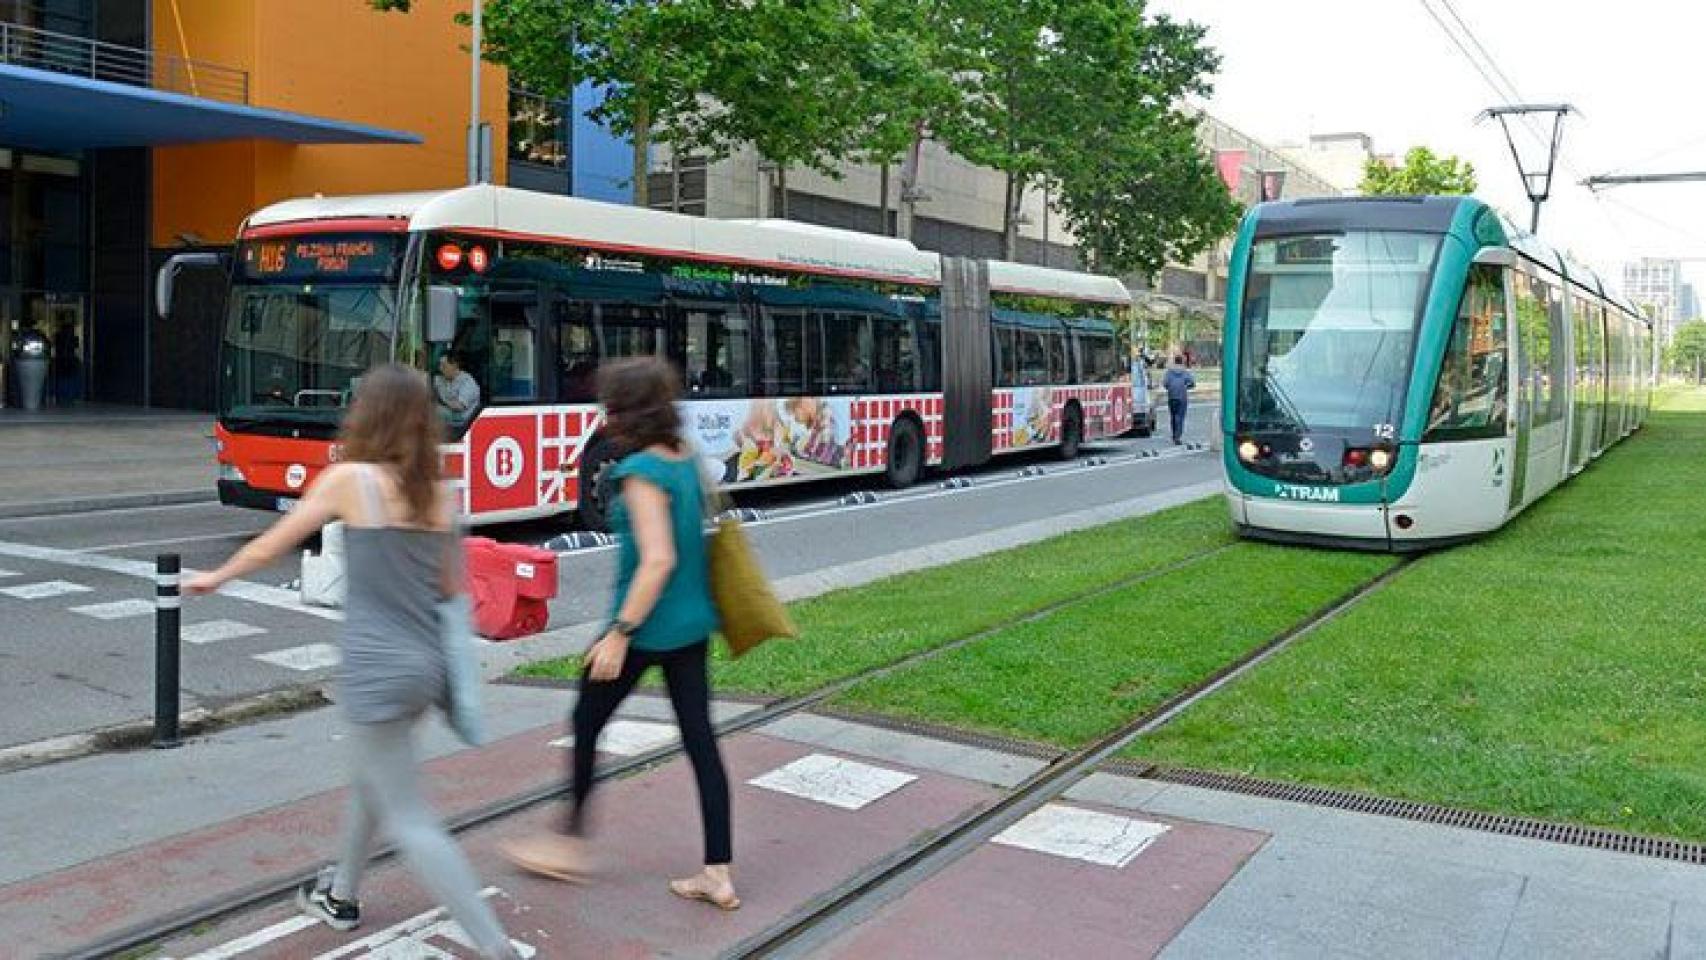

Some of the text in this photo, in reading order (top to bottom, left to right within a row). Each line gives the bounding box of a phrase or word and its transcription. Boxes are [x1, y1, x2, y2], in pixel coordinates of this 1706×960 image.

[1373, 423, 1394, 439] 12
[495, 447, 513, 476] B
[1290, 486, 1339, 502] TRAM
